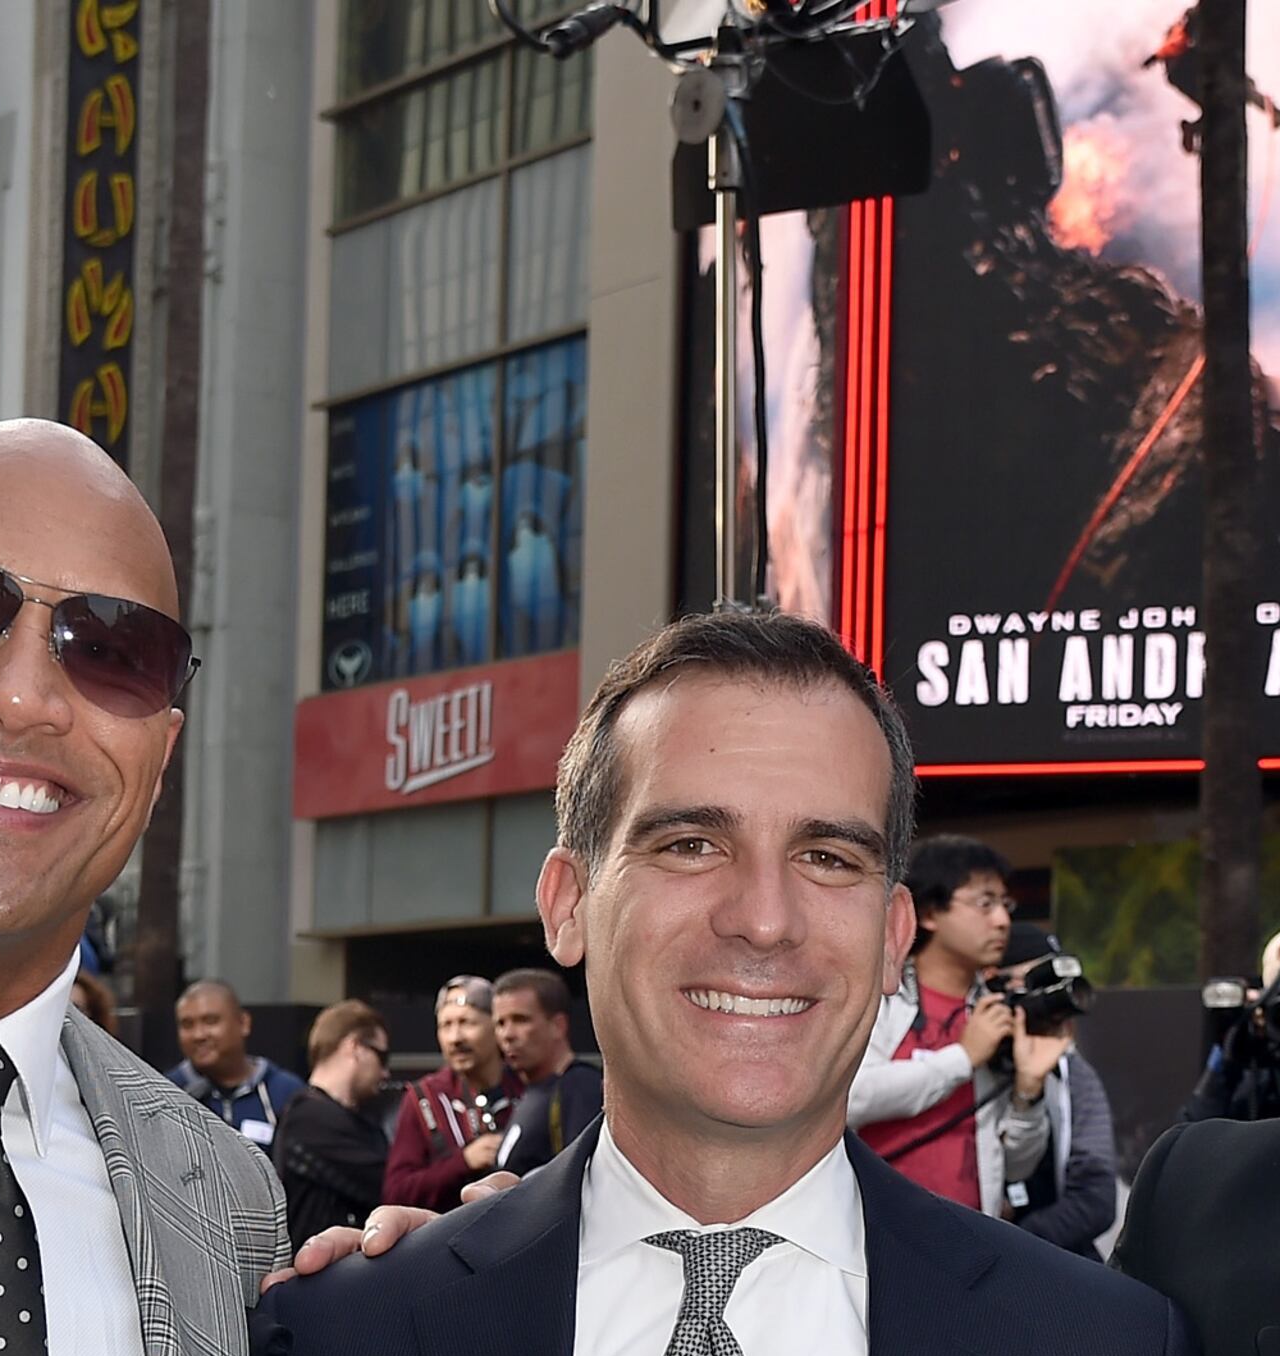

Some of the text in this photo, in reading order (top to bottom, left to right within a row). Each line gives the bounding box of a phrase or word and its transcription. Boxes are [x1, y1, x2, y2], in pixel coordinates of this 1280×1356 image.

[947, 609, 1101, 636] DWAYNE
[915, 637, 1030, 706] SAN
[1066, 702, 1184, 729] FRIDAY
